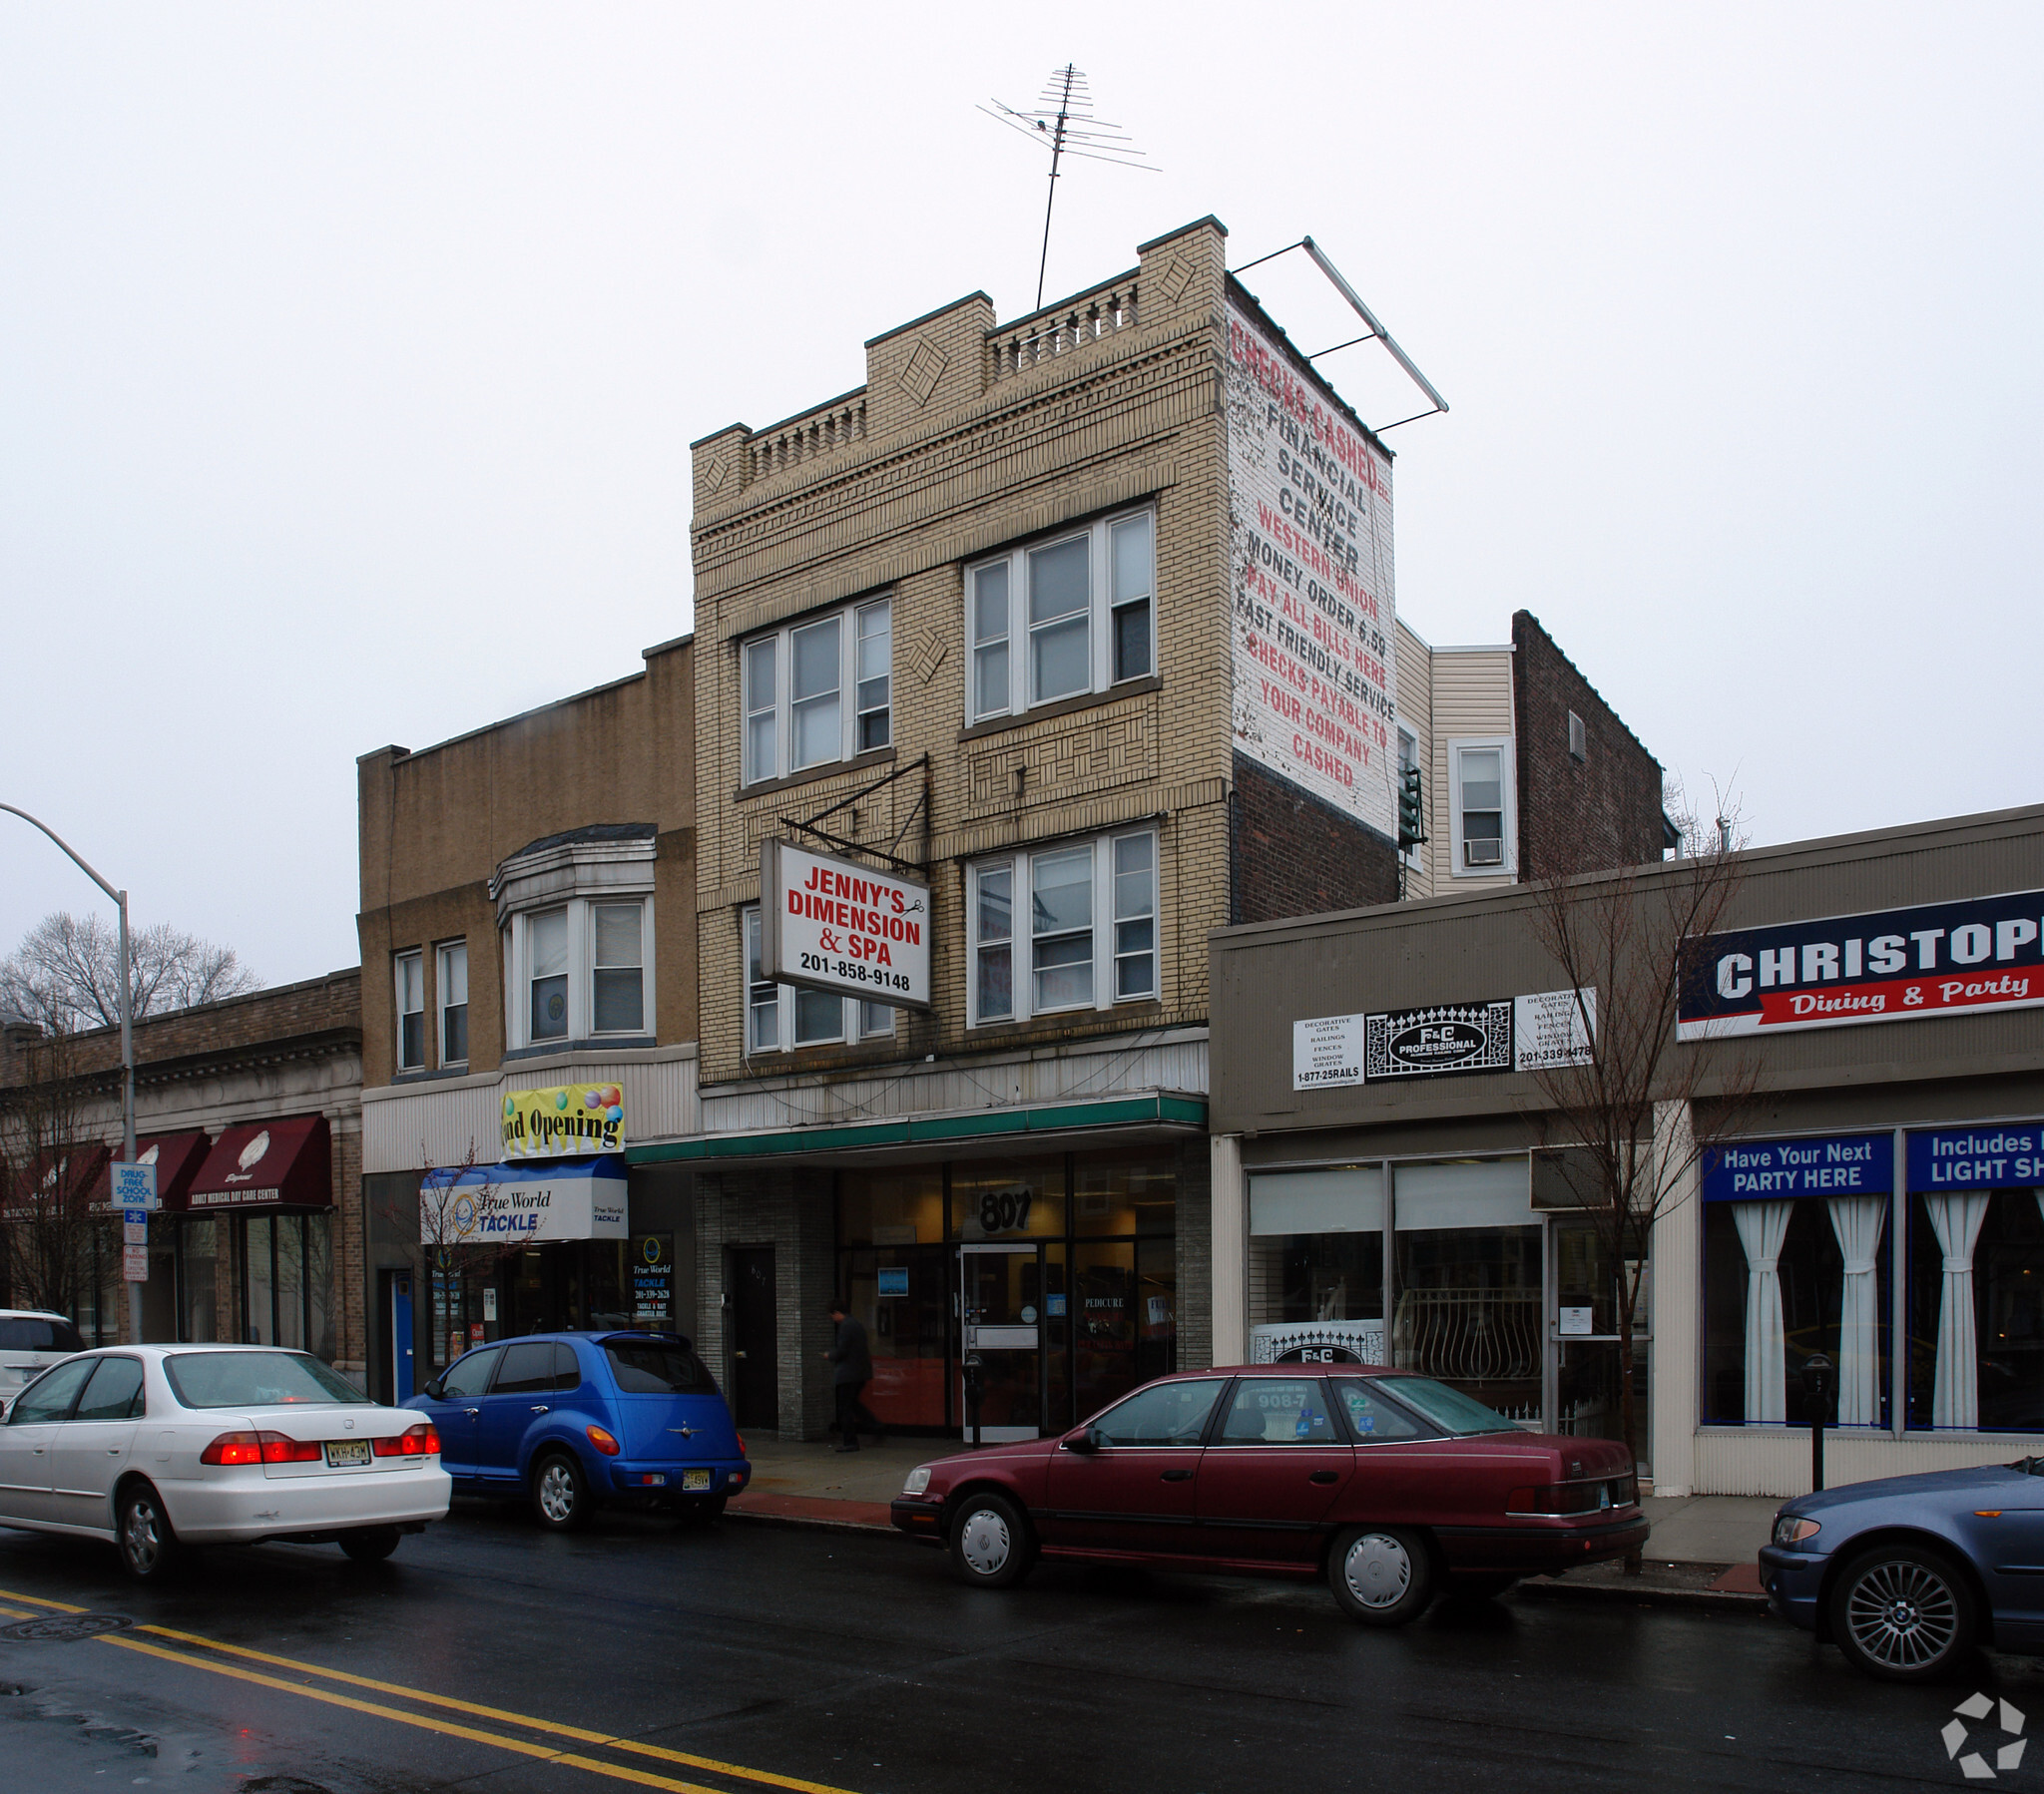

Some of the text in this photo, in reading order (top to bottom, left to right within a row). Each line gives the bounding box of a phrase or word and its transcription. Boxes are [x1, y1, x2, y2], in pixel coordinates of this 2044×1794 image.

[1231, 319, 1307, 425] CHECKS
[1313, 402, 1377, 491] CASHED
[1267, 403, 1366, 516] FINANCIAL
[1278, 448, 1358, 540] SERVICE
[1278, 487, 1358, 577] CENTER
[1258, 499, 1378, 622] WESTERN UNION
[1248, 529, 1302, 589] MONEY
[1307, 579, 1355, 634] ORDER
[1248, 566, 1386, 690] PAY ALL BILLS HERE
[1238, 591, 1395, 723] FAST FRIENDLY SERVICE
[1248, 632, 1387, 748] CHECKS PAYABLE TO
[1261, 678, 1370, 766] YOUR COMPANY
[1293, 733, 1353, 788] CASHED
[804, 866, 905, 914] JENNY'S
[787, 888, 920, 946] DIMENSION
[819, 927, 892, 967] & SPA
[1717, 915, 2044, 1000] CHRISTOP
[800, 952, 910, 991] 201-858-9148
[1527, 993, 1578, 1005] DECORATIV
[1789, 975, 2030, 1015] Dining & Party
[1304, 1018, 1351, 1029] DECORATIVE
[1420, 1026, 1455, 1044] F&C
[1399, 1040, 1476, 1054] PROFESSIONAL
[1298, 1067, 1359, 1083] 1-877-25RAILS
[530, 1109, 621, 1148] Opening
[1932, 1132, 2033, 1157] Includes
[1725, 1141, 1872, 1168] Have Your Next
[1932, 1159, 2008, 1182] LIGHT
[117, 1186, 152, 1195] SCHOOL
[192, 1187, 279, 1205] ADULT MEDICAL DAY CARE CENTER
[1734, 1166, 1862, 1192] PARTY HERE
[480, 1190, 551, 1211] True World
[980, 1189, 1032, 1232] 807
[480, 1213, 538, 1232] TACKLE
[634, 1264, 671, 1274] True World
[634, 1278, 666, 1287] TACKLE
[1085, 1297, 1124, 1308] PEDICURE
